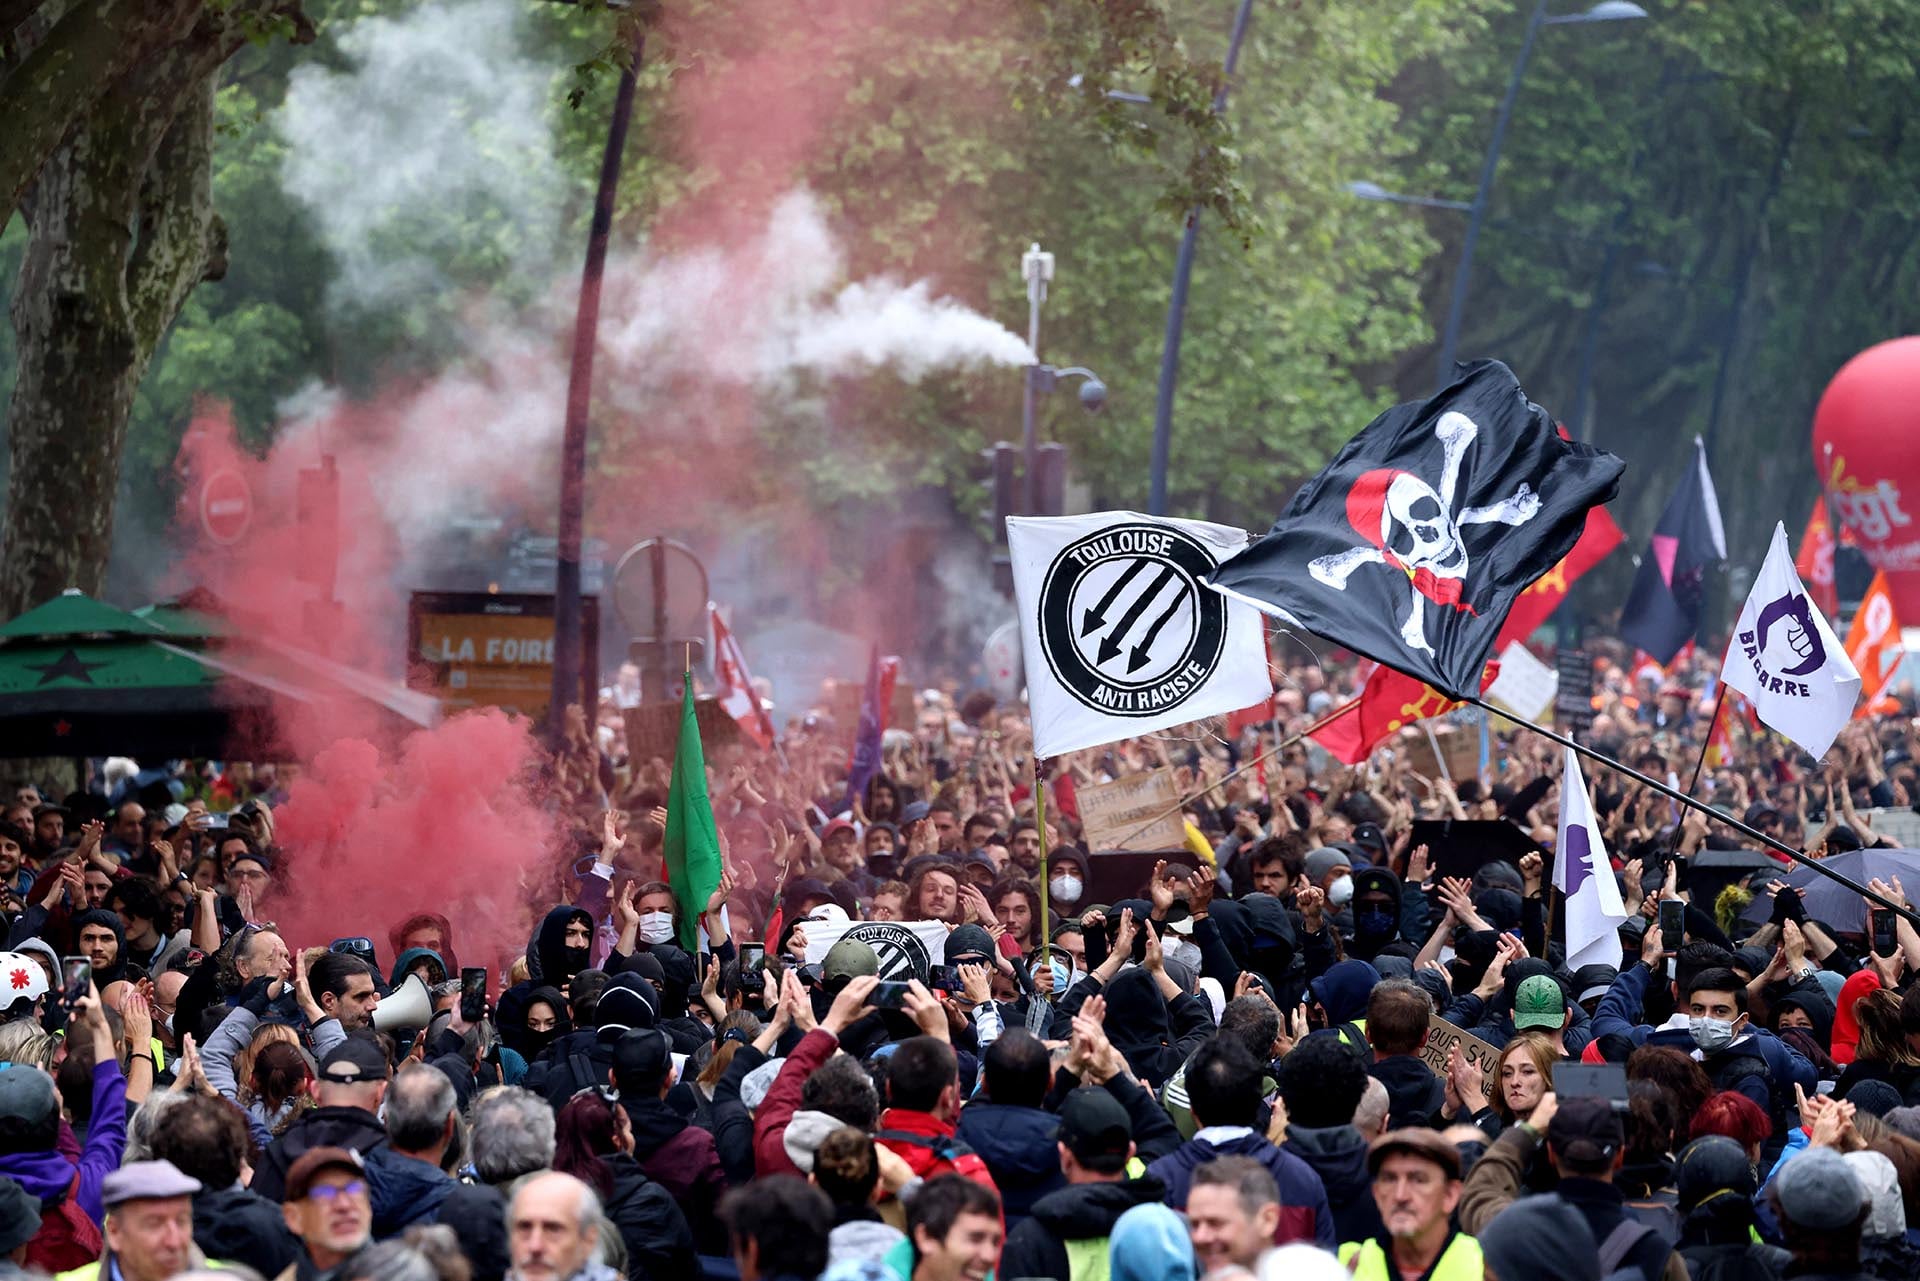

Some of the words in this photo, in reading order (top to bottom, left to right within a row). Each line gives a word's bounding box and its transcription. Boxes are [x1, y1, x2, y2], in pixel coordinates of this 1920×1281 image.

[1832, 480, 1912, 540] cgt
[1069, 531, 1174, 566] TOULOUSE
[441, 636, 475, 661] LA
[1738, 630, 1810, 697] BAGARRE
[1091, 683, 1132, 709] ANTI
[1138, 659, 1206, 709] RACISTE
[852, 927, 910, 947] TOULOUSE
[1428, 1027, 1461, 1050] OUR
[1418, 1045, 1449, 1073] OTRE
